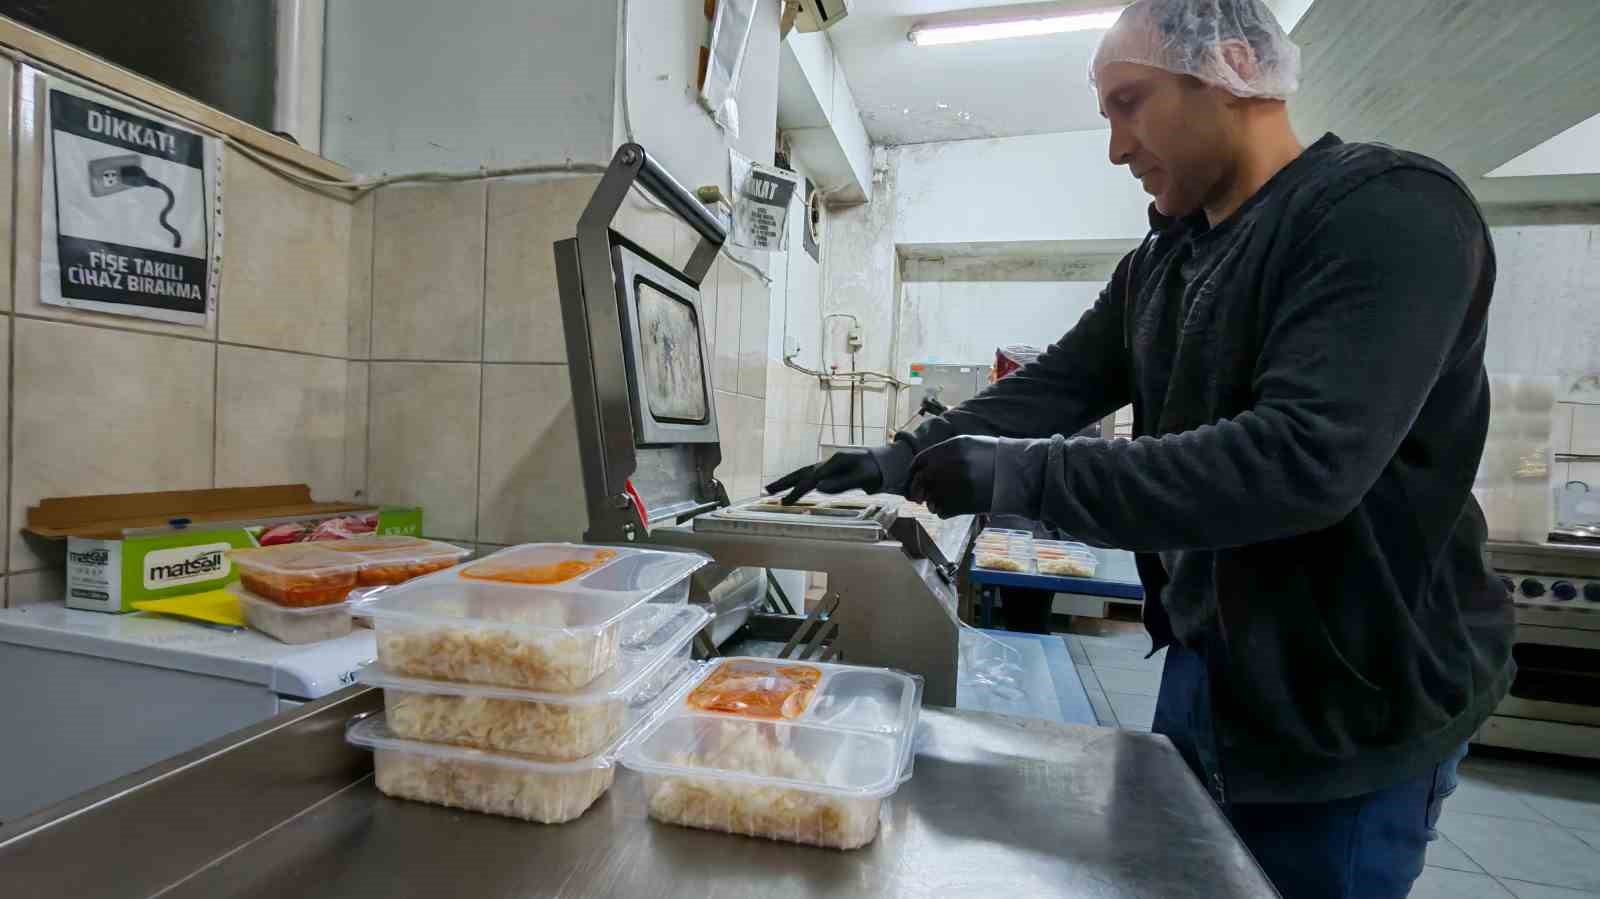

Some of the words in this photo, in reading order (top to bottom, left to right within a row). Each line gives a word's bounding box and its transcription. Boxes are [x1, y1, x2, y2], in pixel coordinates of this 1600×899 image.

[87, 110, 177, 154] DİKKAT!
[68, 263, 123, 289] CİHAZ
[127, 275, 202, 300] BIRAKMA
[89, 249, 128, 276] FİŞE
[134, 258, 184, 280] TAKILI
